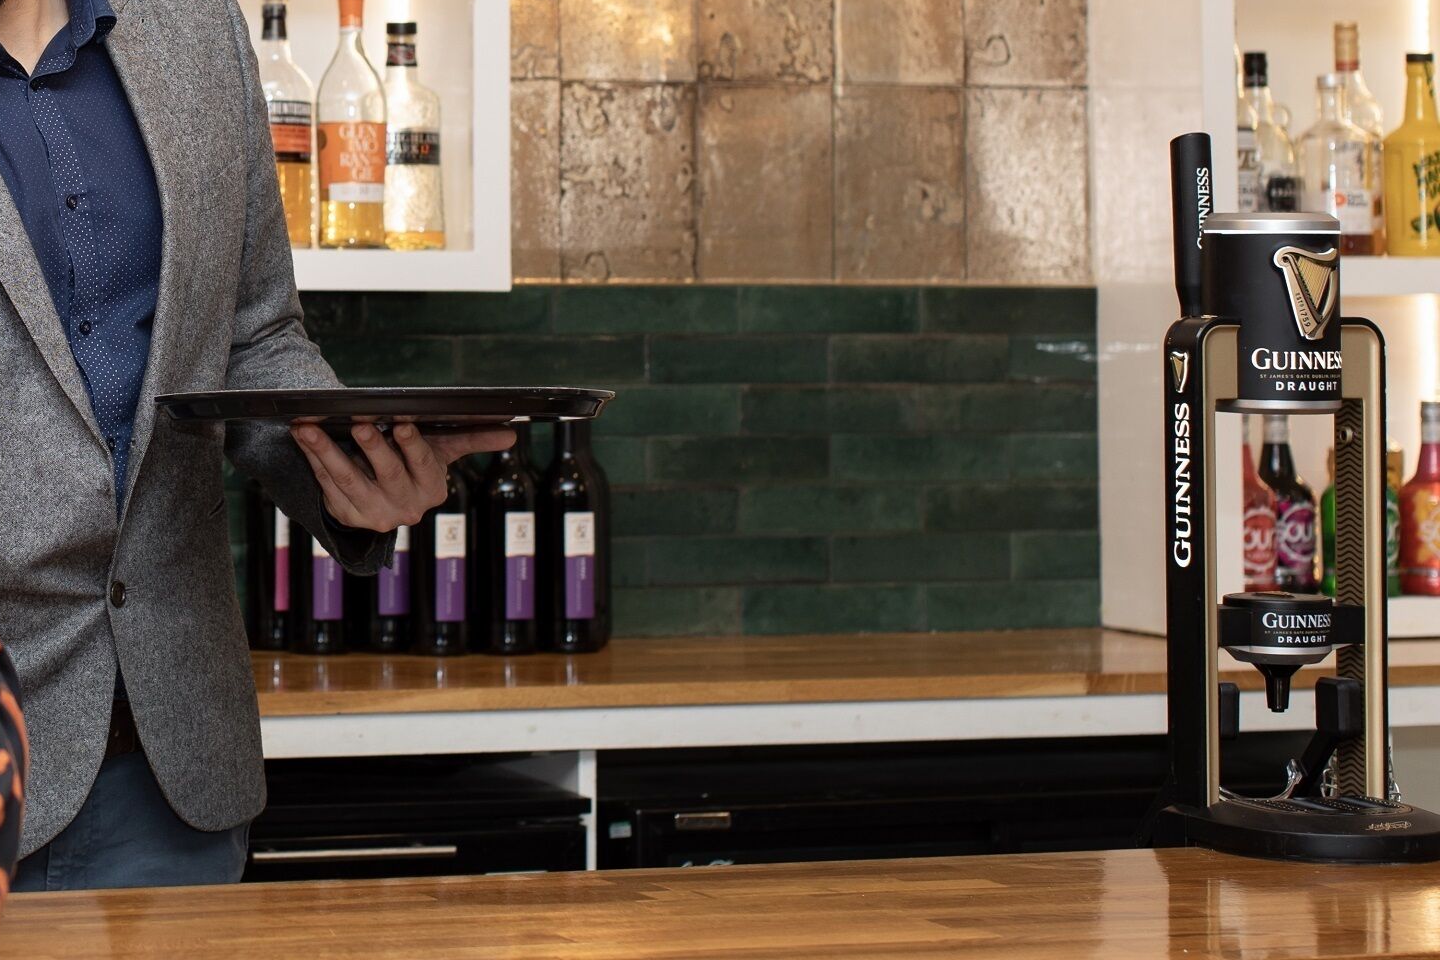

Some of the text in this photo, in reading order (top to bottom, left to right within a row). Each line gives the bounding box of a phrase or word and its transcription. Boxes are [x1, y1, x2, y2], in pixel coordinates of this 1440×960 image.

[1299, 307, 1311, 328] 1759
[1275, 381, 1338, 391] DRAUGHT
[1173, 402, 1191, 569] GUINNESS
[1262, 612, 1331, 629] GUINNESS
[1278, 635, 1327, 644] DRAUGHT
